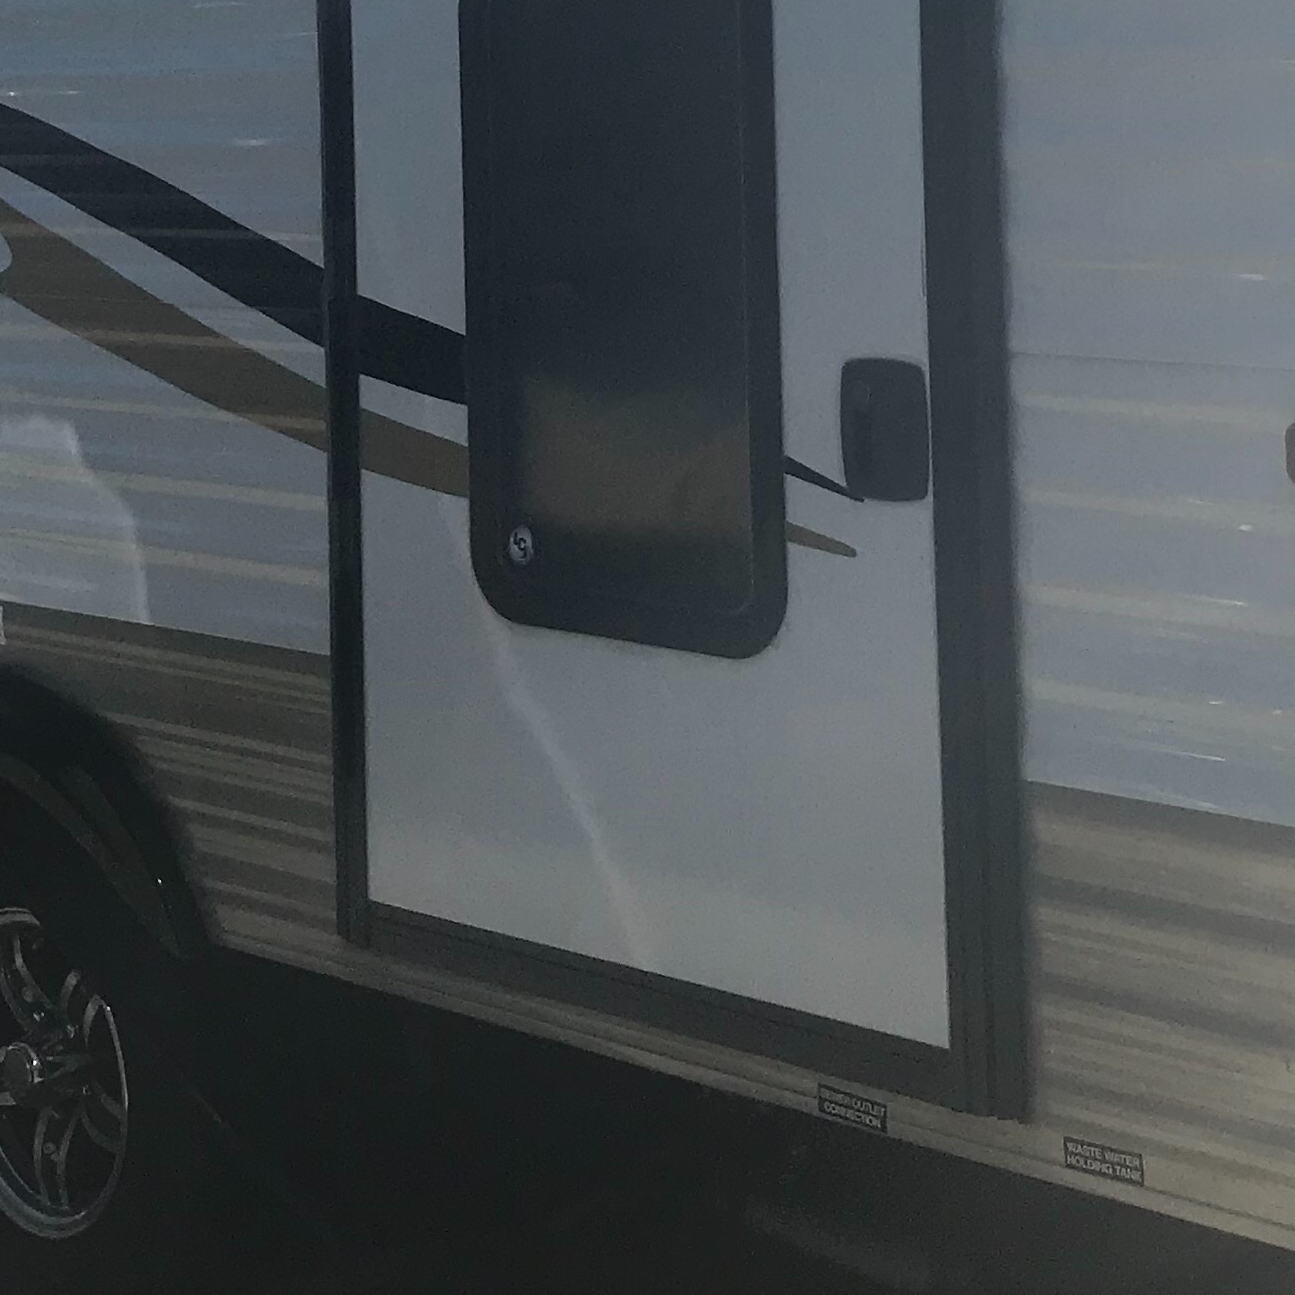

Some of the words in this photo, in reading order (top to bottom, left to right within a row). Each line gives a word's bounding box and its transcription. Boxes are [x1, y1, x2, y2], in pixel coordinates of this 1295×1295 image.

[1066, 1142, 1103, 1159] WASTE
[1104, 1151, 1141, 1168] WATER
[1066, 1155, 1113, 1174] HOLDING
[1115, 1165, 1142, 1182] TANK
